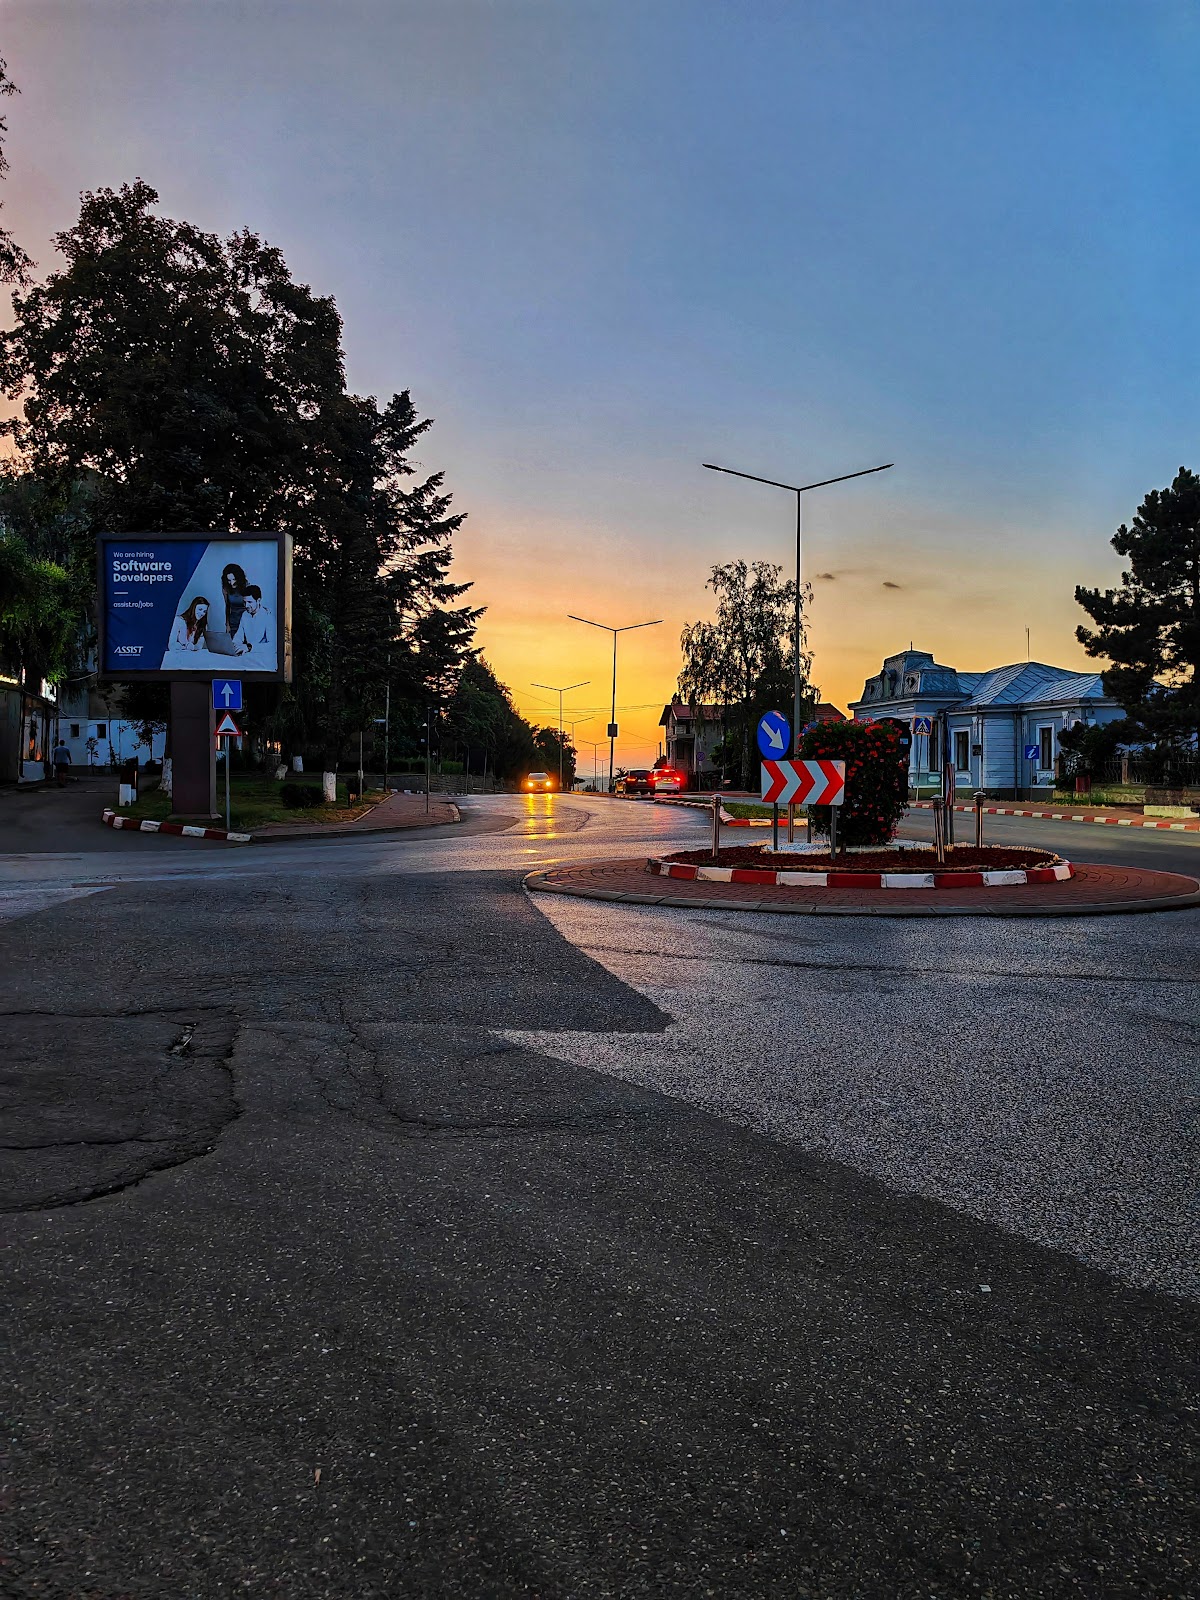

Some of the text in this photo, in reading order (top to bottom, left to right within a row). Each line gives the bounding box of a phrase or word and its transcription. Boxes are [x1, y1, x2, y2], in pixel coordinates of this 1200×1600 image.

[136, 551, 154, 559] hiring
[113, 560, 172, 571] Software
[113, 573, 173, 585] Developers
[113, 600, 153, 609] assist.ro/jobs
